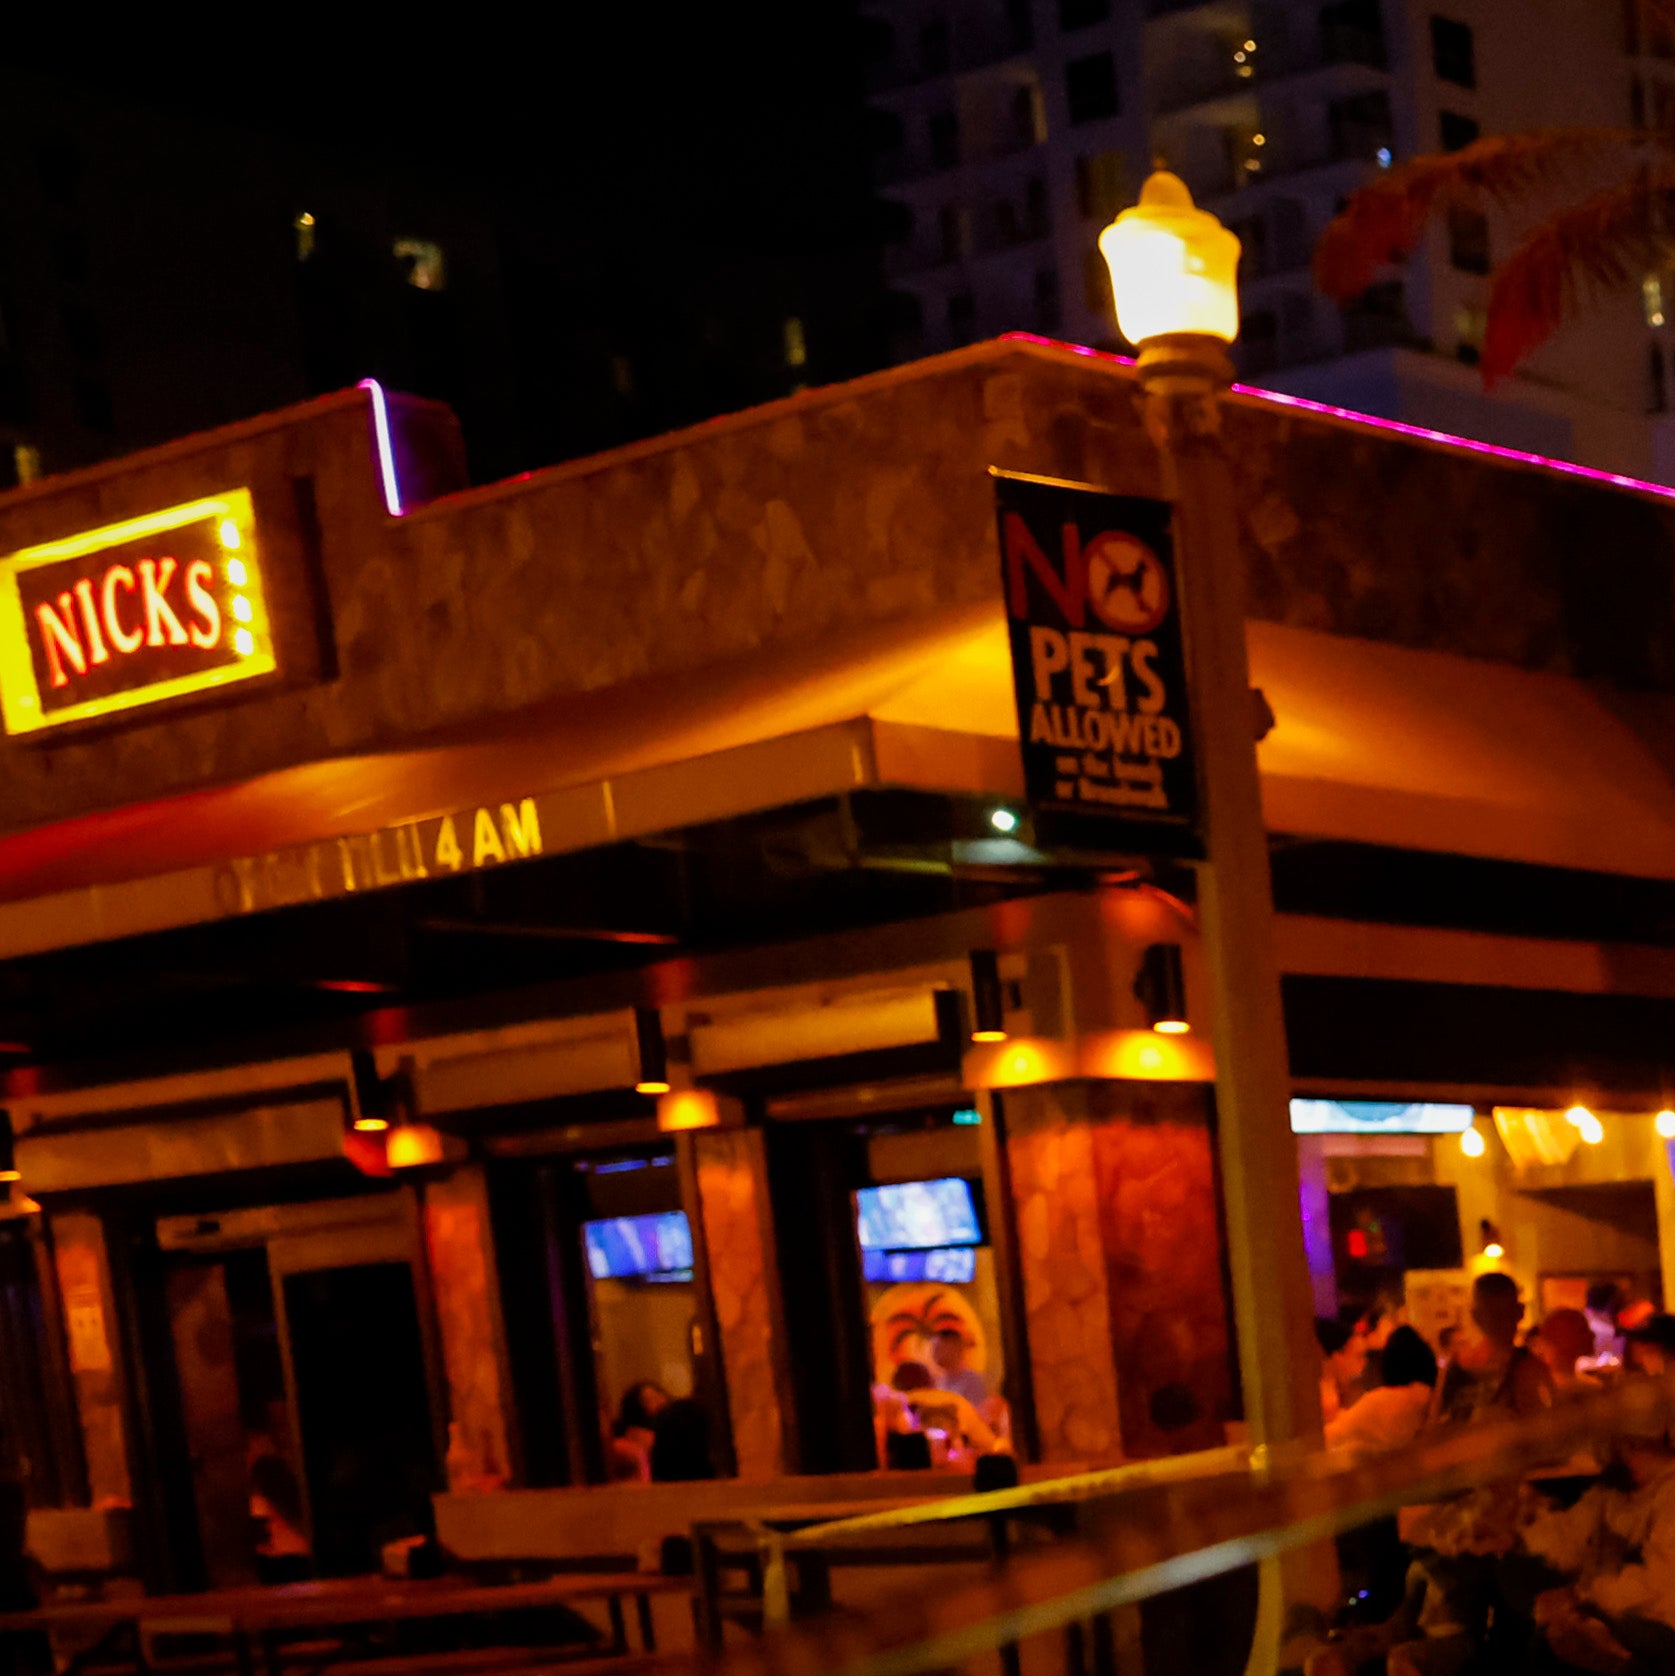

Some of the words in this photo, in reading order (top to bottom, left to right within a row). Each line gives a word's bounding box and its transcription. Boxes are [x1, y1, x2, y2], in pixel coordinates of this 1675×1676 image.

[36, 556, 222, 688] NICKS
[1028, 624, 1168, 716] PETS
[1029, 700, 1183, 761] ALLOWED
[435, 813, 464, 871] 4
[472, 797, 544, 867] AM
